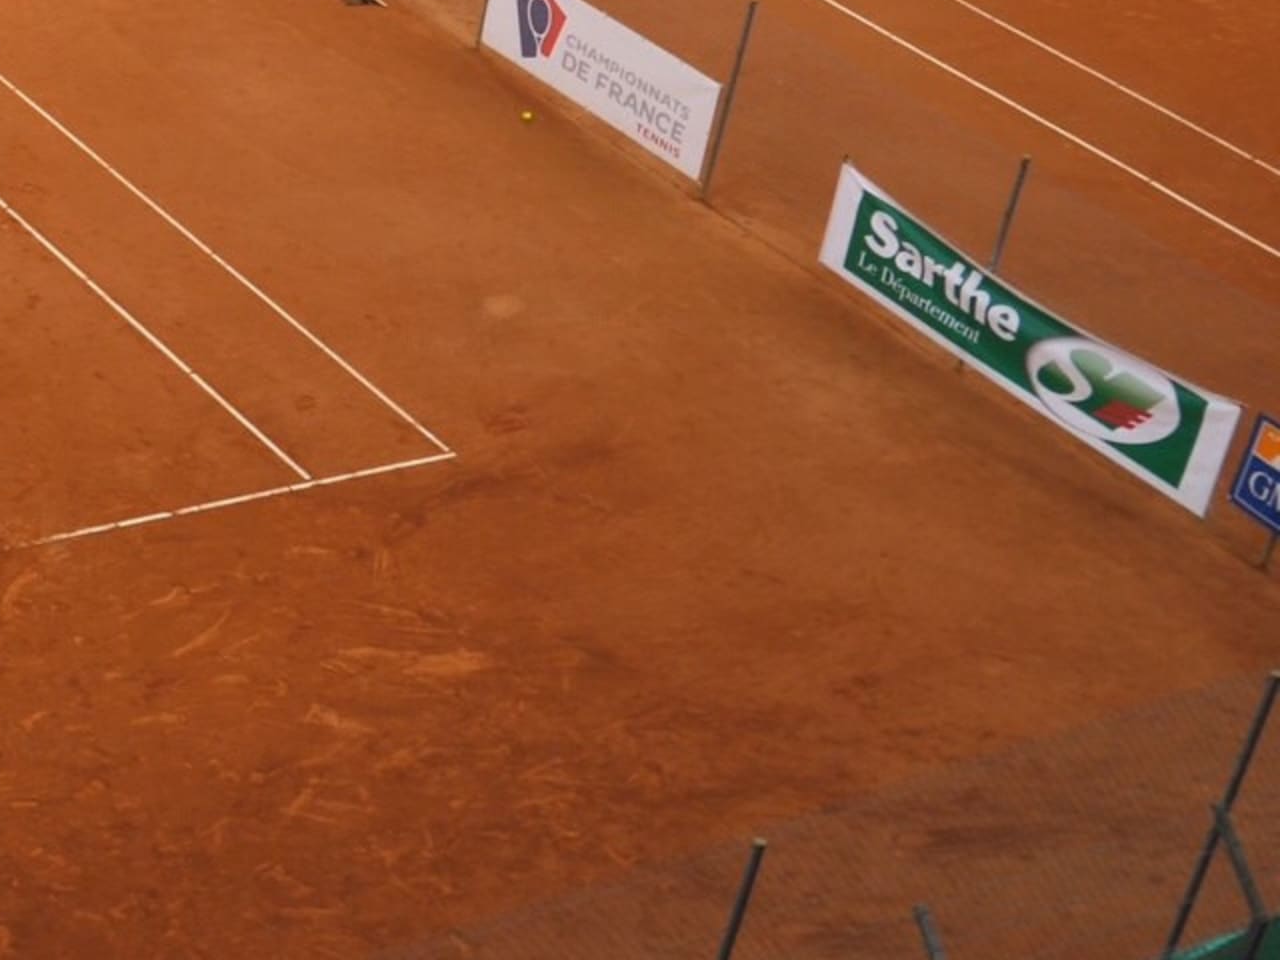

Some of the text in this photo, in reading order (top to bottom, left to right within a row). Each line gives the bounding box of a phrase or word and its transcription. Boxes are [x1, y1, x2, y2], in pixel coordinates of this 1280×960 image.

[561, 51, 686, 144] DE FRANCE
[566, 34, 689, 121] CHAMPIONNATS
[636, 123, 681, 159] TENNIS
[858, 251, 980, 343] Le Département
[864, 210, 1021, 341] Sarthe
